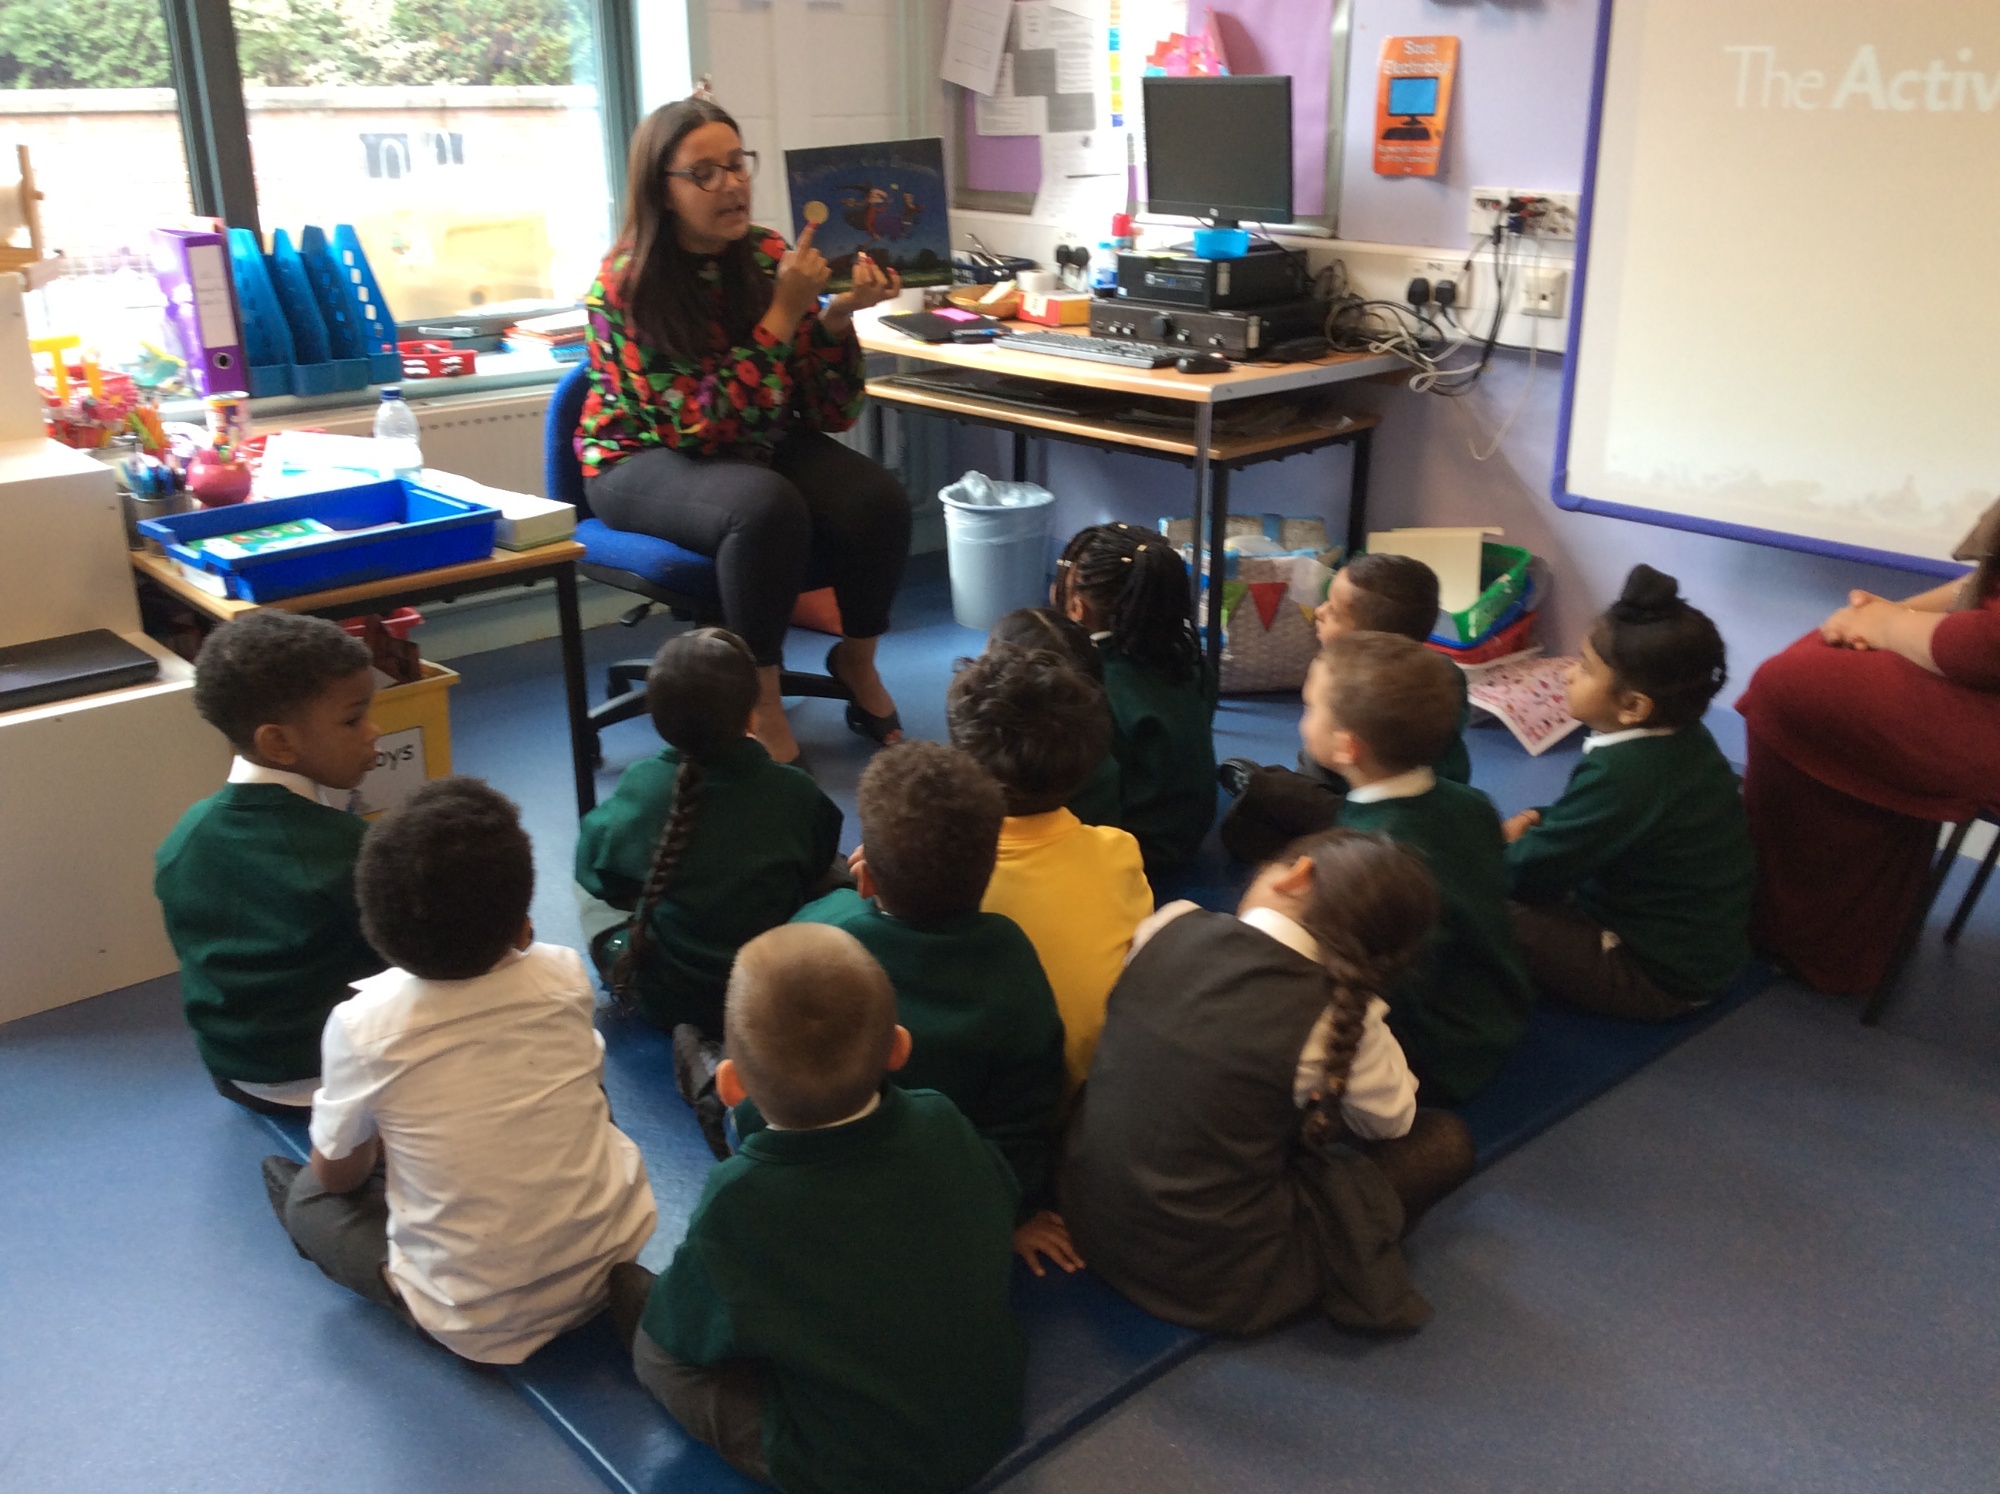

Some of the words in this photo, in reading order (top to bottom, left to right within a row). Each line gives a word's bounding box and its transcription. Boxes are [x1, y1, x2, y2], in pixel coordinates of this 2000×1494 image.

[1403, 40, 1437, 55] Save
[1722, 44, 1825, 110] The
[374, 743, 415, 771] oys
